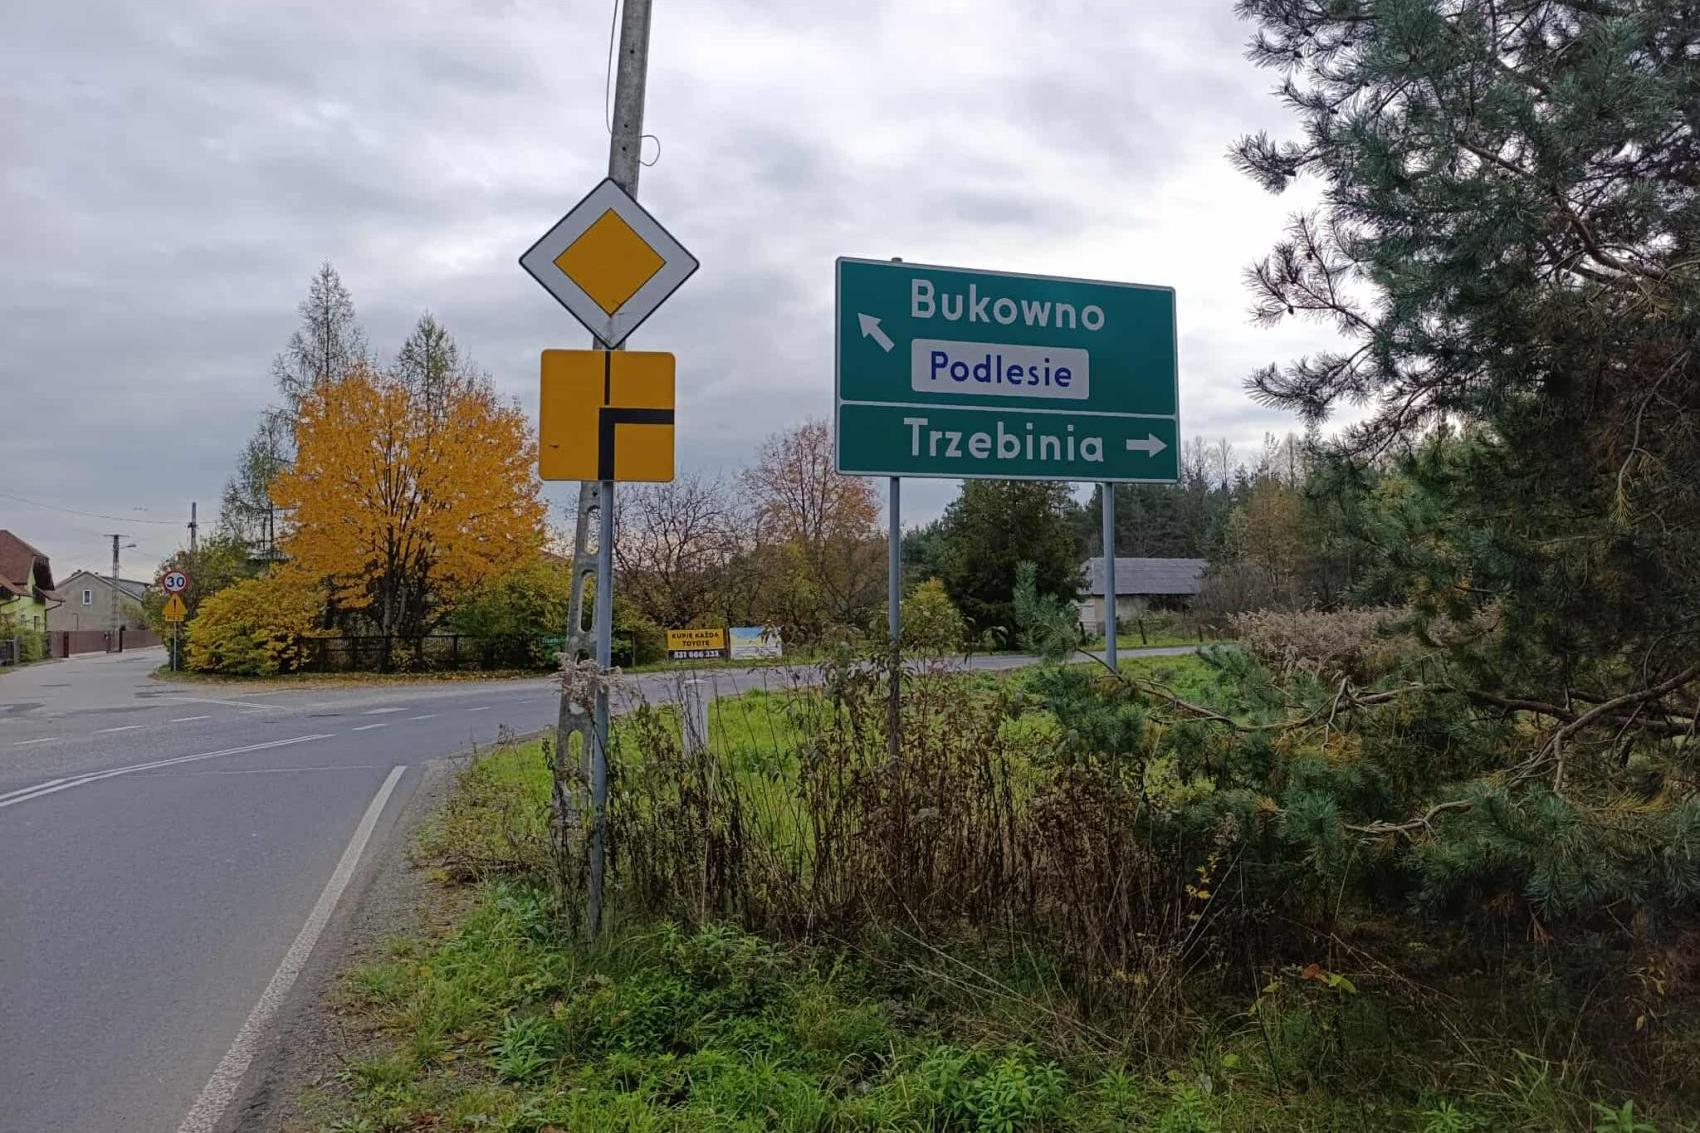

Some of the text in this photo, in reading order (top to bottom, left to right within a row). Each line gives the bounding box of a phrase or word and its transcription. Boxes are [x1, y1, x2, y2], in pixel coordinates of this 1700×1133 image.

[911, 278, 1105, 332] Bukowno
[930, 351, 1072, 388] Podlesie
[903, 417, 1105, 462] Trzebinia
[167, 576, 185, 588] 30
